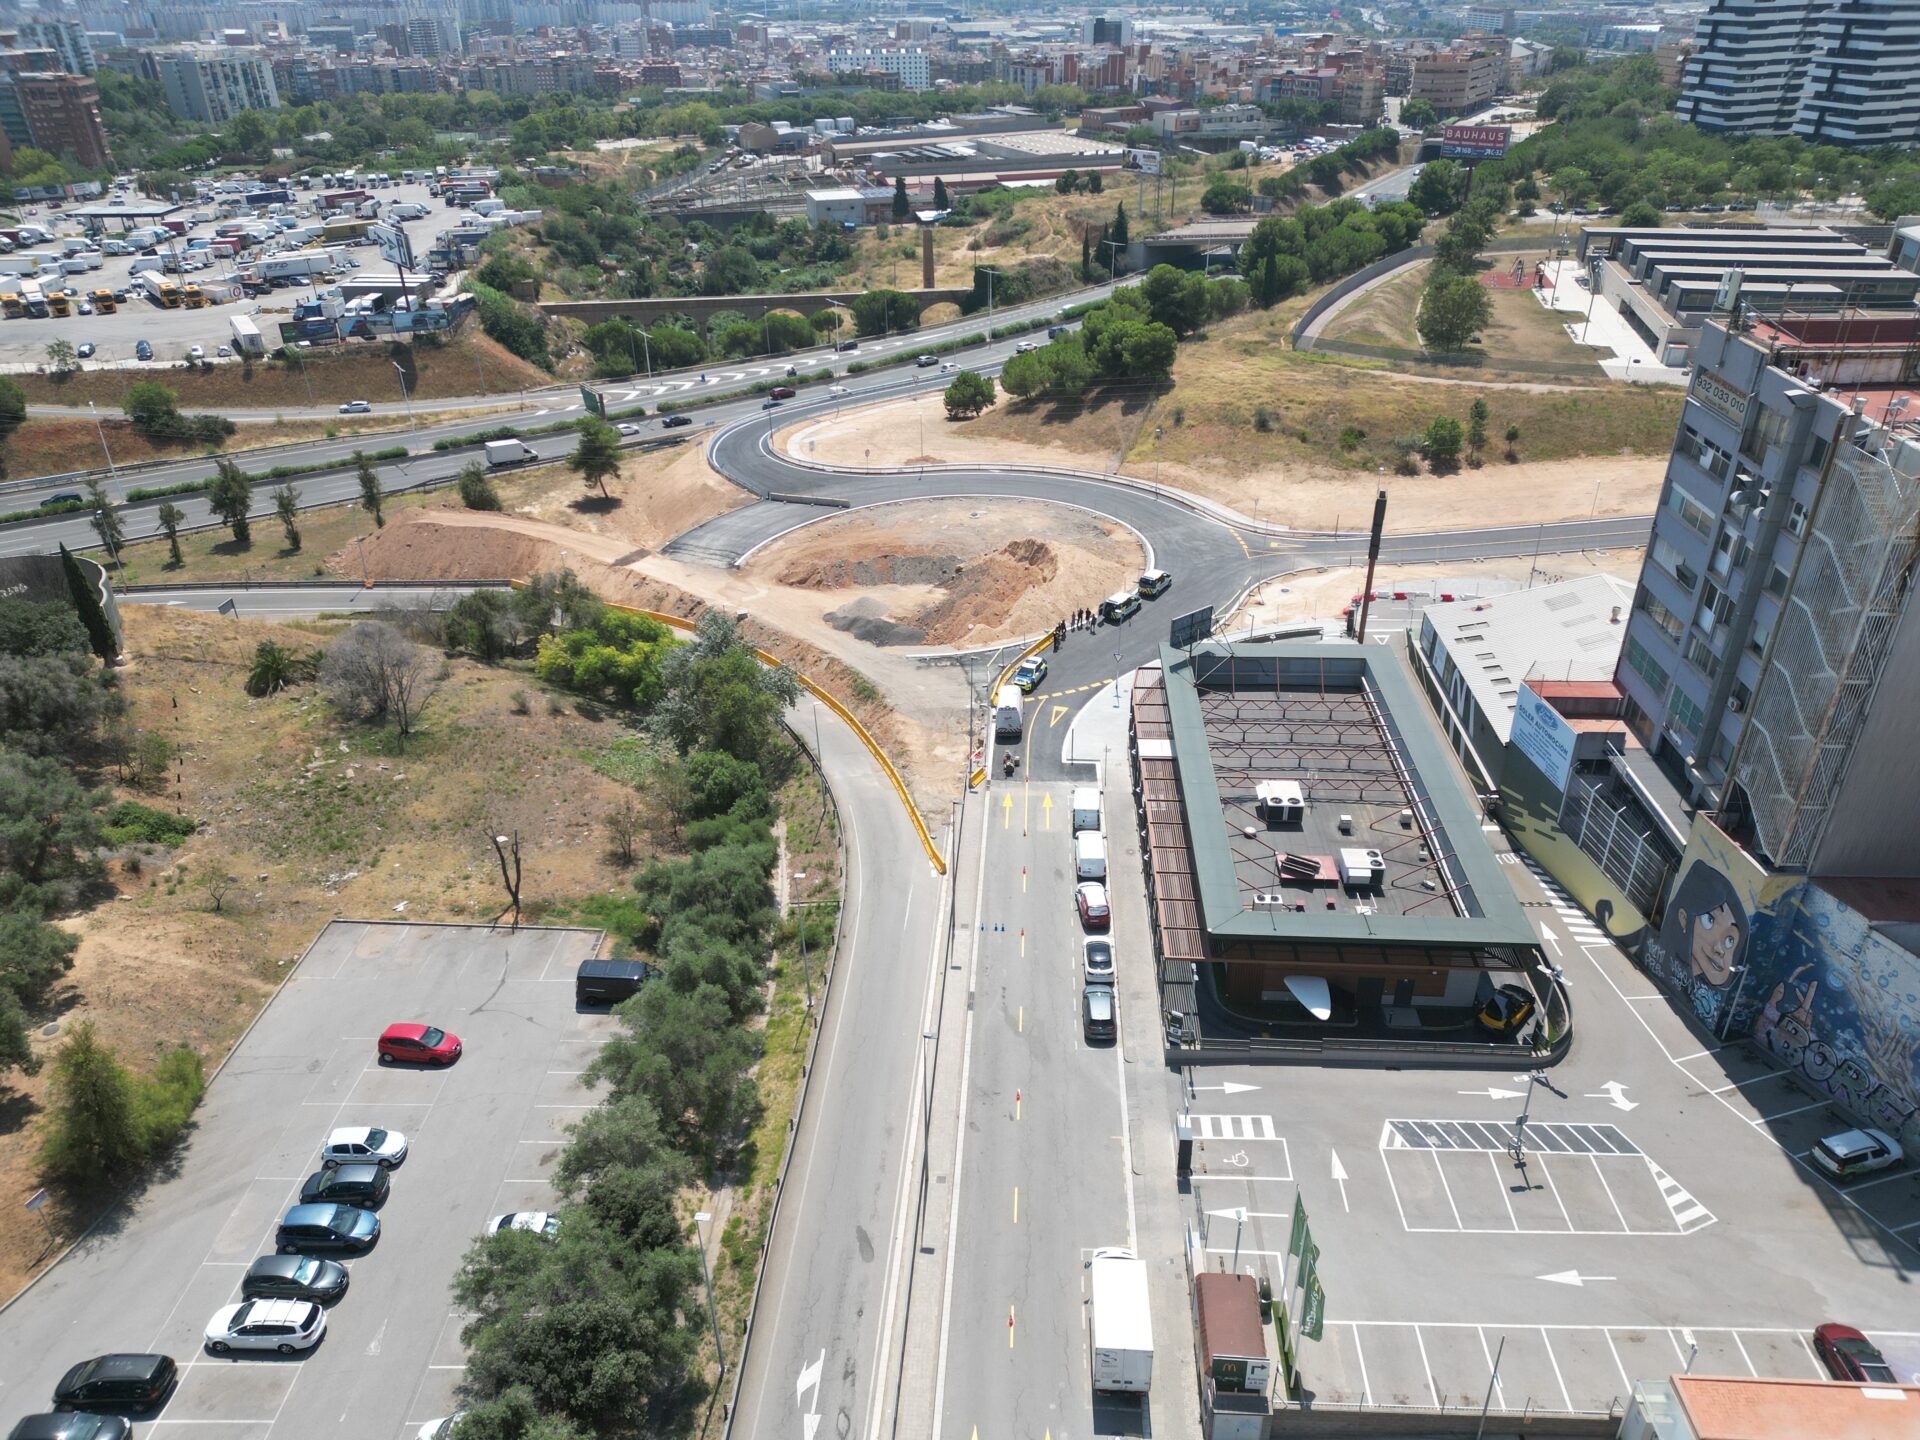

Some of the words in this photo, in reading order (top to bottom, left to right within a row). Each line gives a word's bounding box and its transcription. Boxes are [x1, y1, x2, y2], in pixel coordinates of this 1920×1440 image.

[1446, 129, 1505, 141] BAUHAUS
[1696, 377, 1713, 393] 932
[1713, 387, 1730, 404] 033
[1730, 396, 1745, 413] 010
[1518, 704, 1535, 724] SOLER
